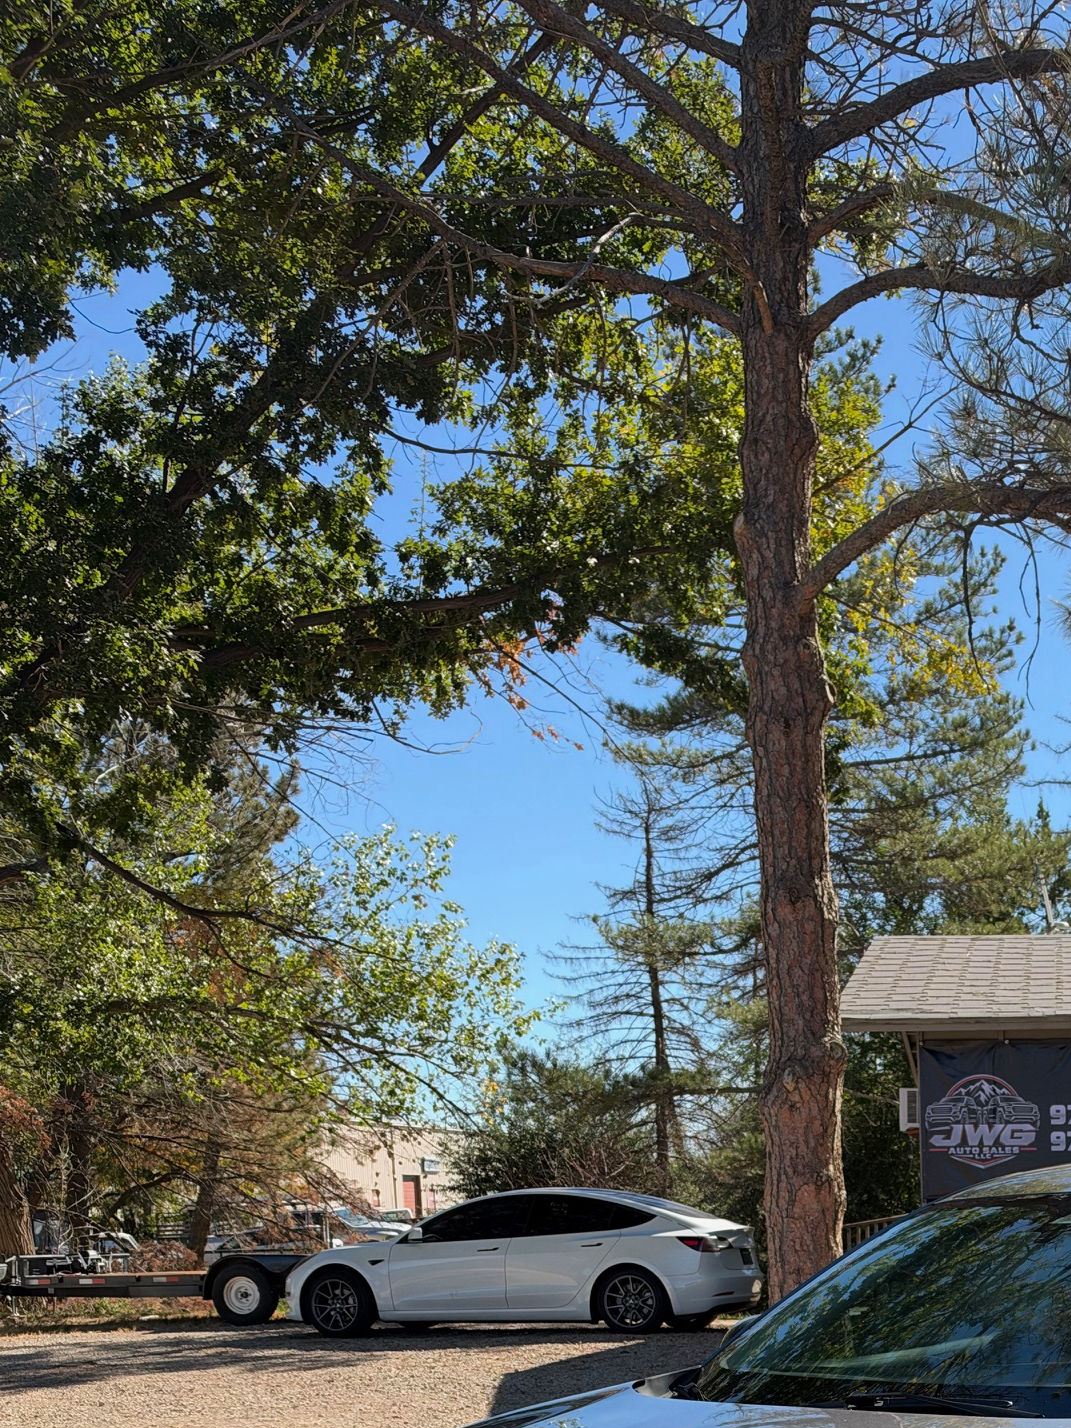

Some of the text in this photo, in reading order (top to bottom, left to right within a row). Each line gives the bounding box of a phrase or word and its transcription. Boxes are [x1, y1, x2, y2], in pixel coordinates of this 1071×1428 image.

[929, 1124, 1037, 1146] JWG
[948, 1146, 1020, 1154] AUTO SALES
